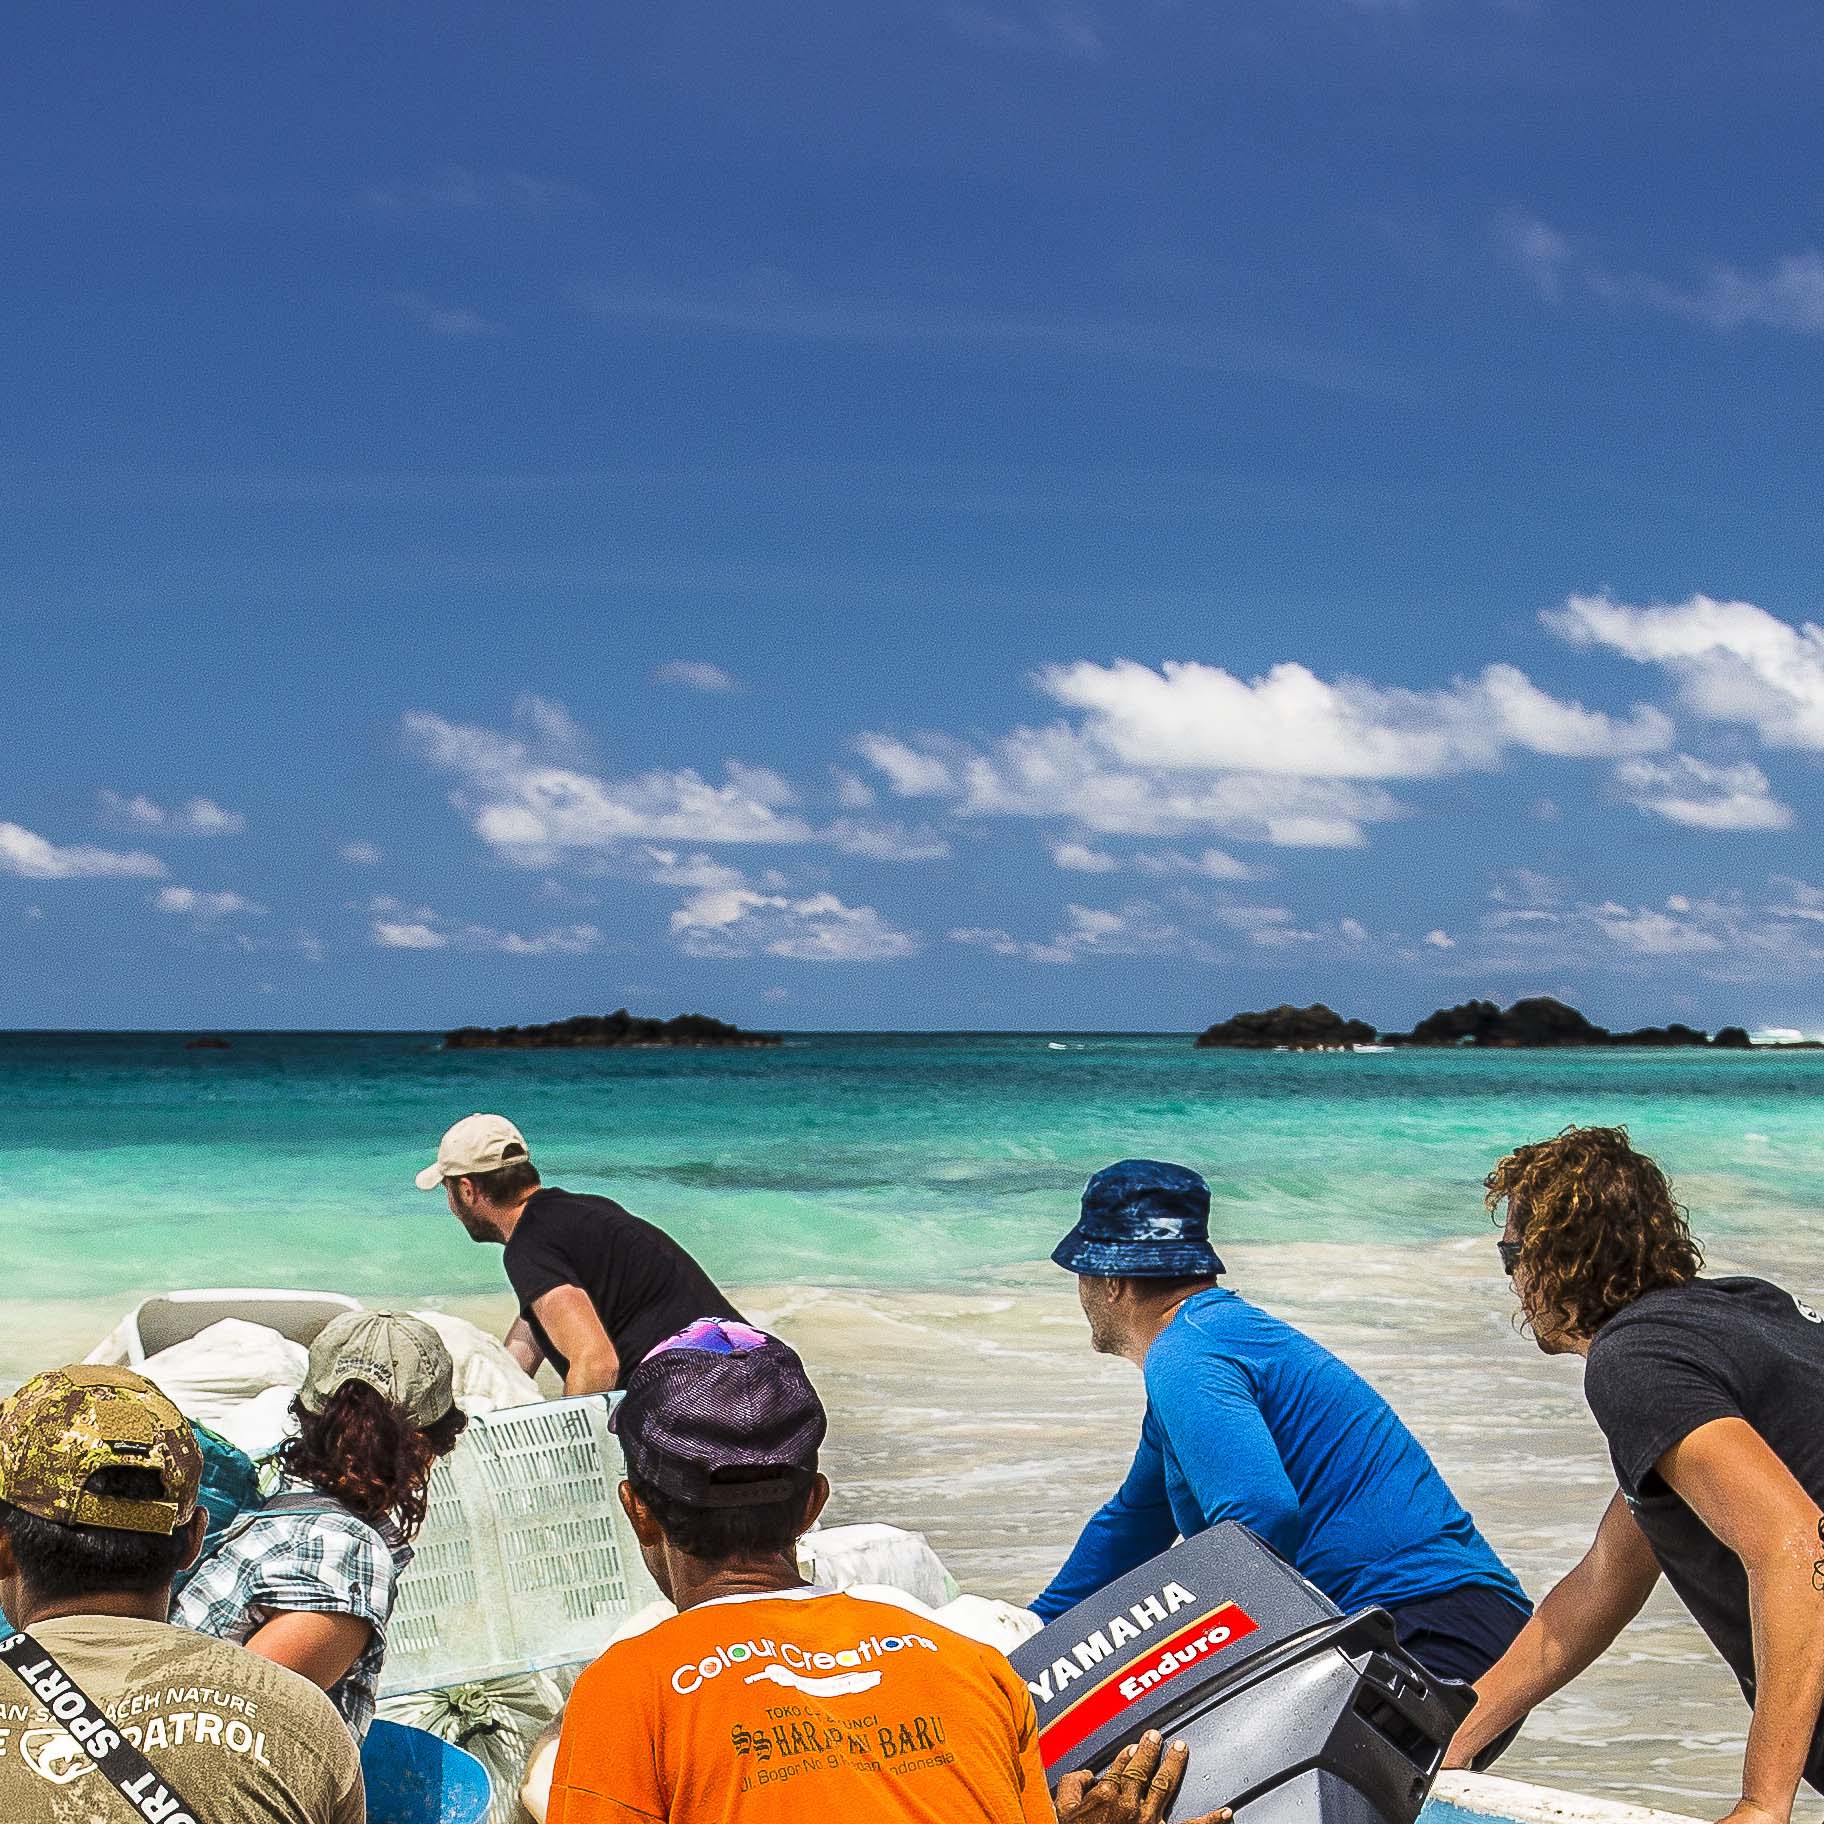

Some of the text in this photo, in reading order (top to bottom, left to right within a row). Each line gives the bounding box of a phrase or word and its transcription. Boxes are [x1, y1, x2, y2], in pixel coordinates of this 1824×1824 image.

[671, 1638, 777, 1695] Colour
[1028, 1581, 1197, 1704] YAMAHA
[1119, 1626, 1230, 1701] Enduro
[18, 1660, 120, 1759] SPORT
[106, 1691, 160, 1721] ACEH
[165, 1687, 258, 1719] NATURE
[765, 1705, 801, 1721] TOKO
[841, 1714, 878, 1730] UNCI
[878, 1716, 946, 1758] BARU
[759, 1763, 801, 1785] Bogor
[890, 1752, 955, 1776] ndonesia
